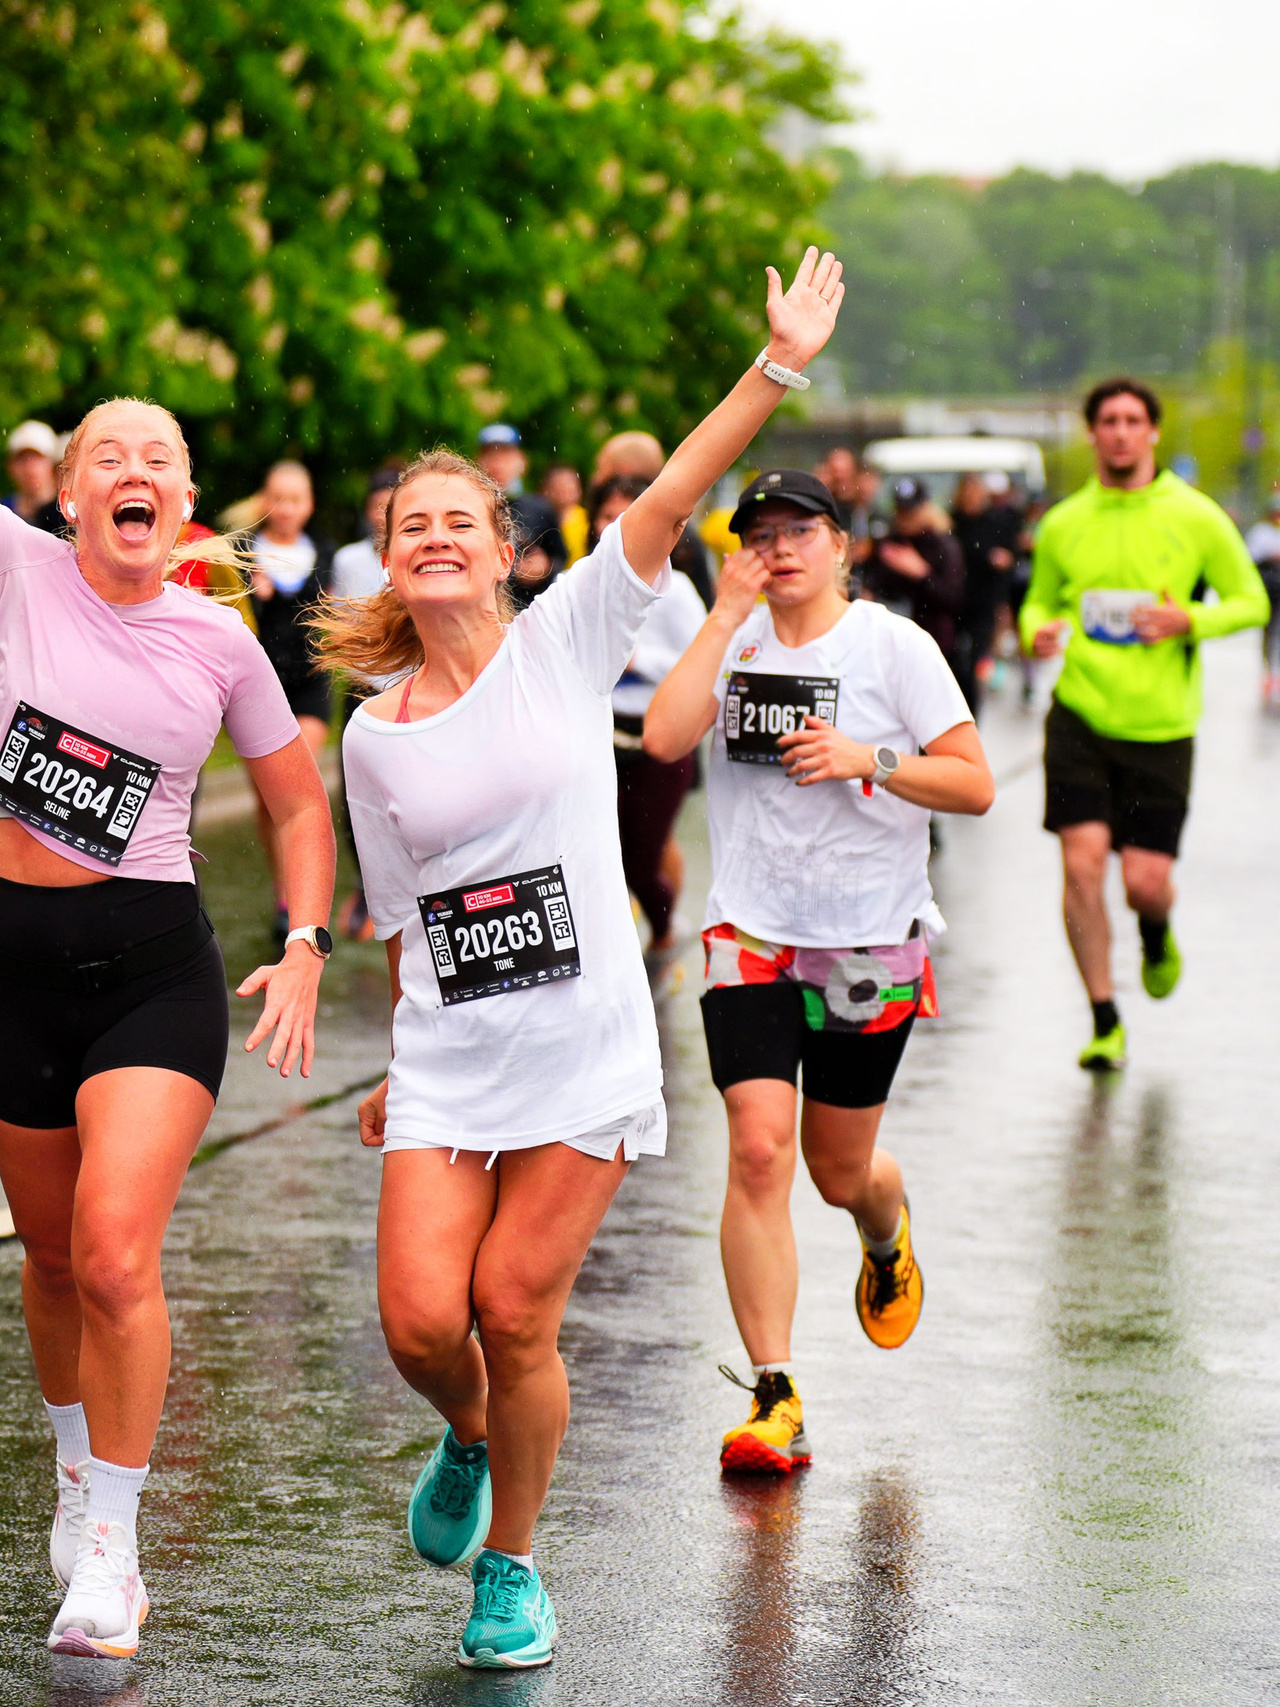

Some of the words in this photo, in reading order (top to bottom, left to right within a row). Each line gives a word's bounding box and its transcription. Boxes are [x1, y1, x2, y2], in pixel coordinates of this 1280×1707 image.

[814, 689, 823, 699] 10
[824, 689, 837, 700] KM
[743, 702, 810, 735] 21067
[63, 738, 72, 748] C
[23, 752, 115, 819] 20264
[126, 770, 138, 783] 10
[136, 775, 152, 789] KM
[43, 800, 72, 821] SELINE
[536, 884, 548, 897] 10
[548, 881, 563, 895] KM
[468, 897, 476, 907] C
[454, 909, 544, 963] 20263
[493, 957, 516, 972] TONE
